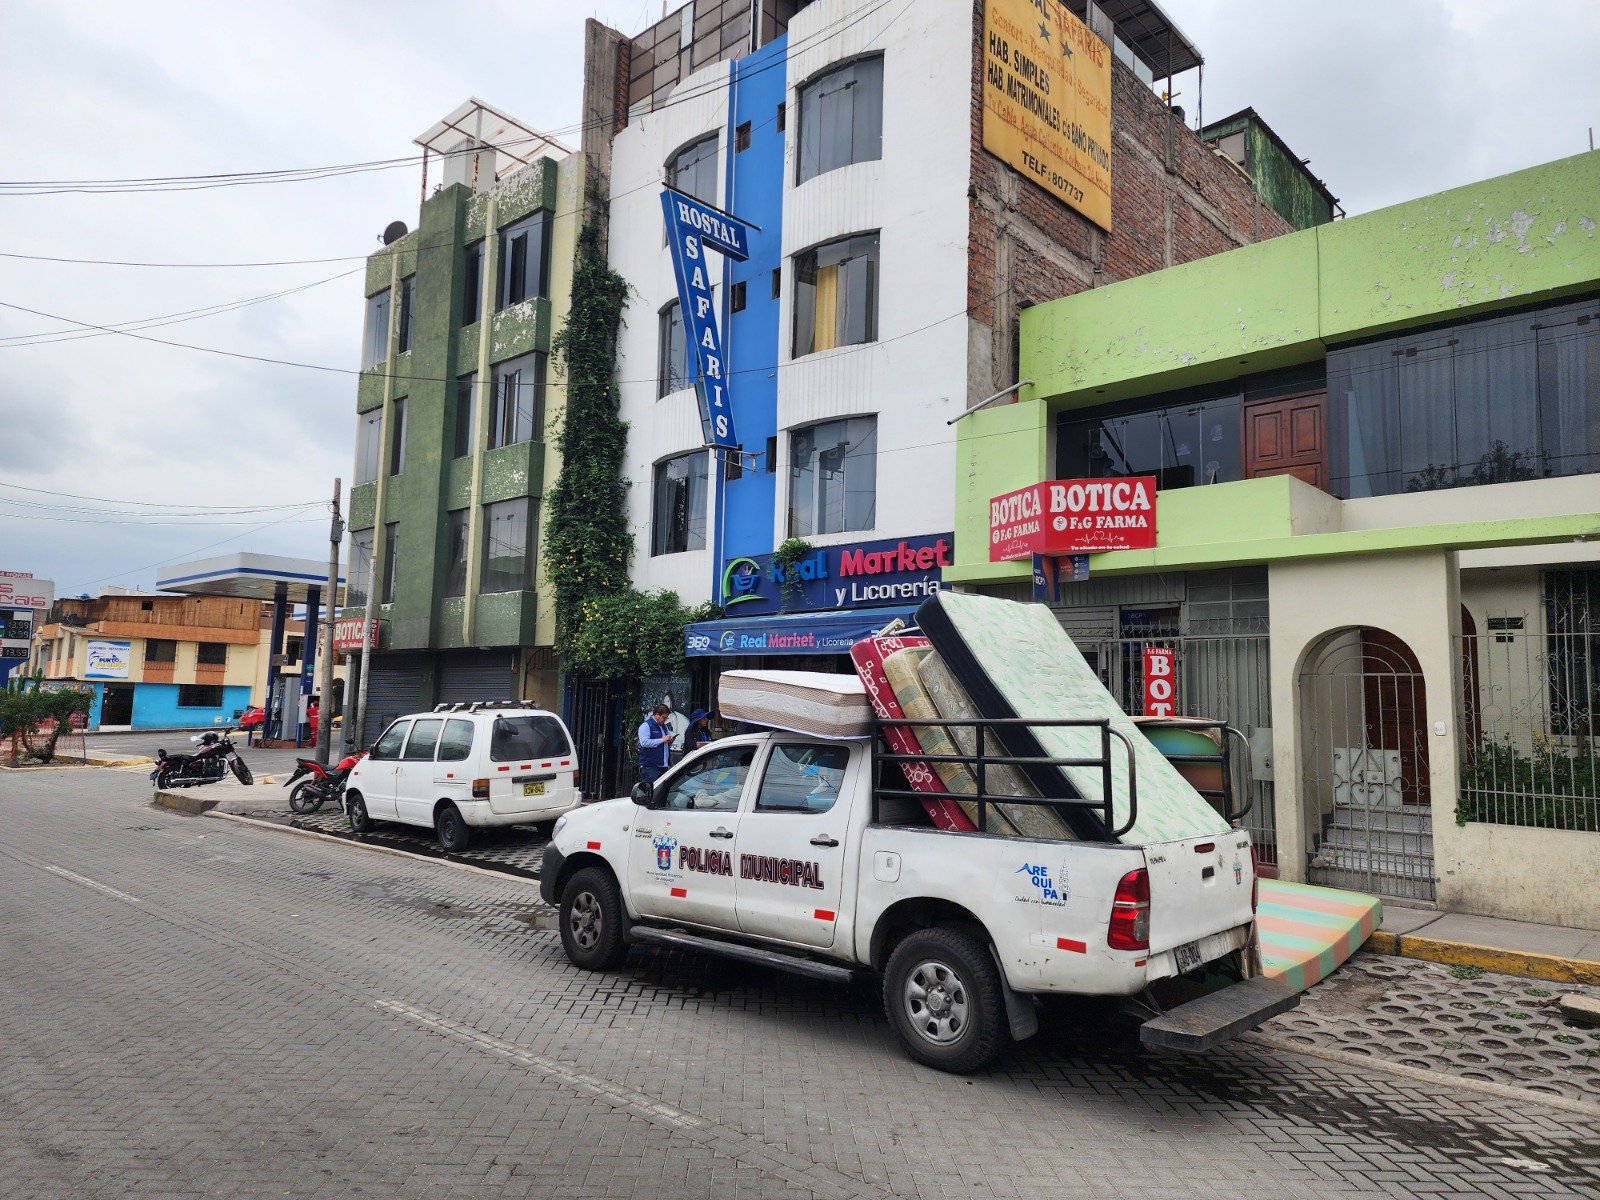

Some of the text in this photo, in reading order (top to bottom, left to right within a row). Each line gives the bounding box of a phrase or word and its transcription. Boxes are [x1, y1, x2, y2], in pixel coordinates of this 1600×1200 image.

[1055, 2, 1103, 69] SAFARIS
[990, 30, 1050, 95] HAB. SIMPLES
[988, 59, 1004, 93] HAB.
[1007, 73, 1060, 132] MATRIMONIALES
[1087, 136, 1109, 172] PRIVADO
[1052, 171, 1084, 204] 807737
[677, 200, 740, 249] HOSTAL
[685, 234, 728, 439] SAFARIS
[991, 488, 1042, 528] BOTICA
[1050, 481, 1151, 514] BOTICA
[1013, 520, 1040, 538] FARMA
[1069, 514, 1148, 530] F&G FARMA
[839, 538, 951, 578] Market
[835, 575, 941, 607] y Licorería
[687, 636, 711, 649] 360
[740, 632, 854, 648] Real Market y Licorería
[679, 845, 733, 877] POLICIA
[740, 853, 825, 890] MUNICIPAL
[1043, 888, 1058, 900] PA
